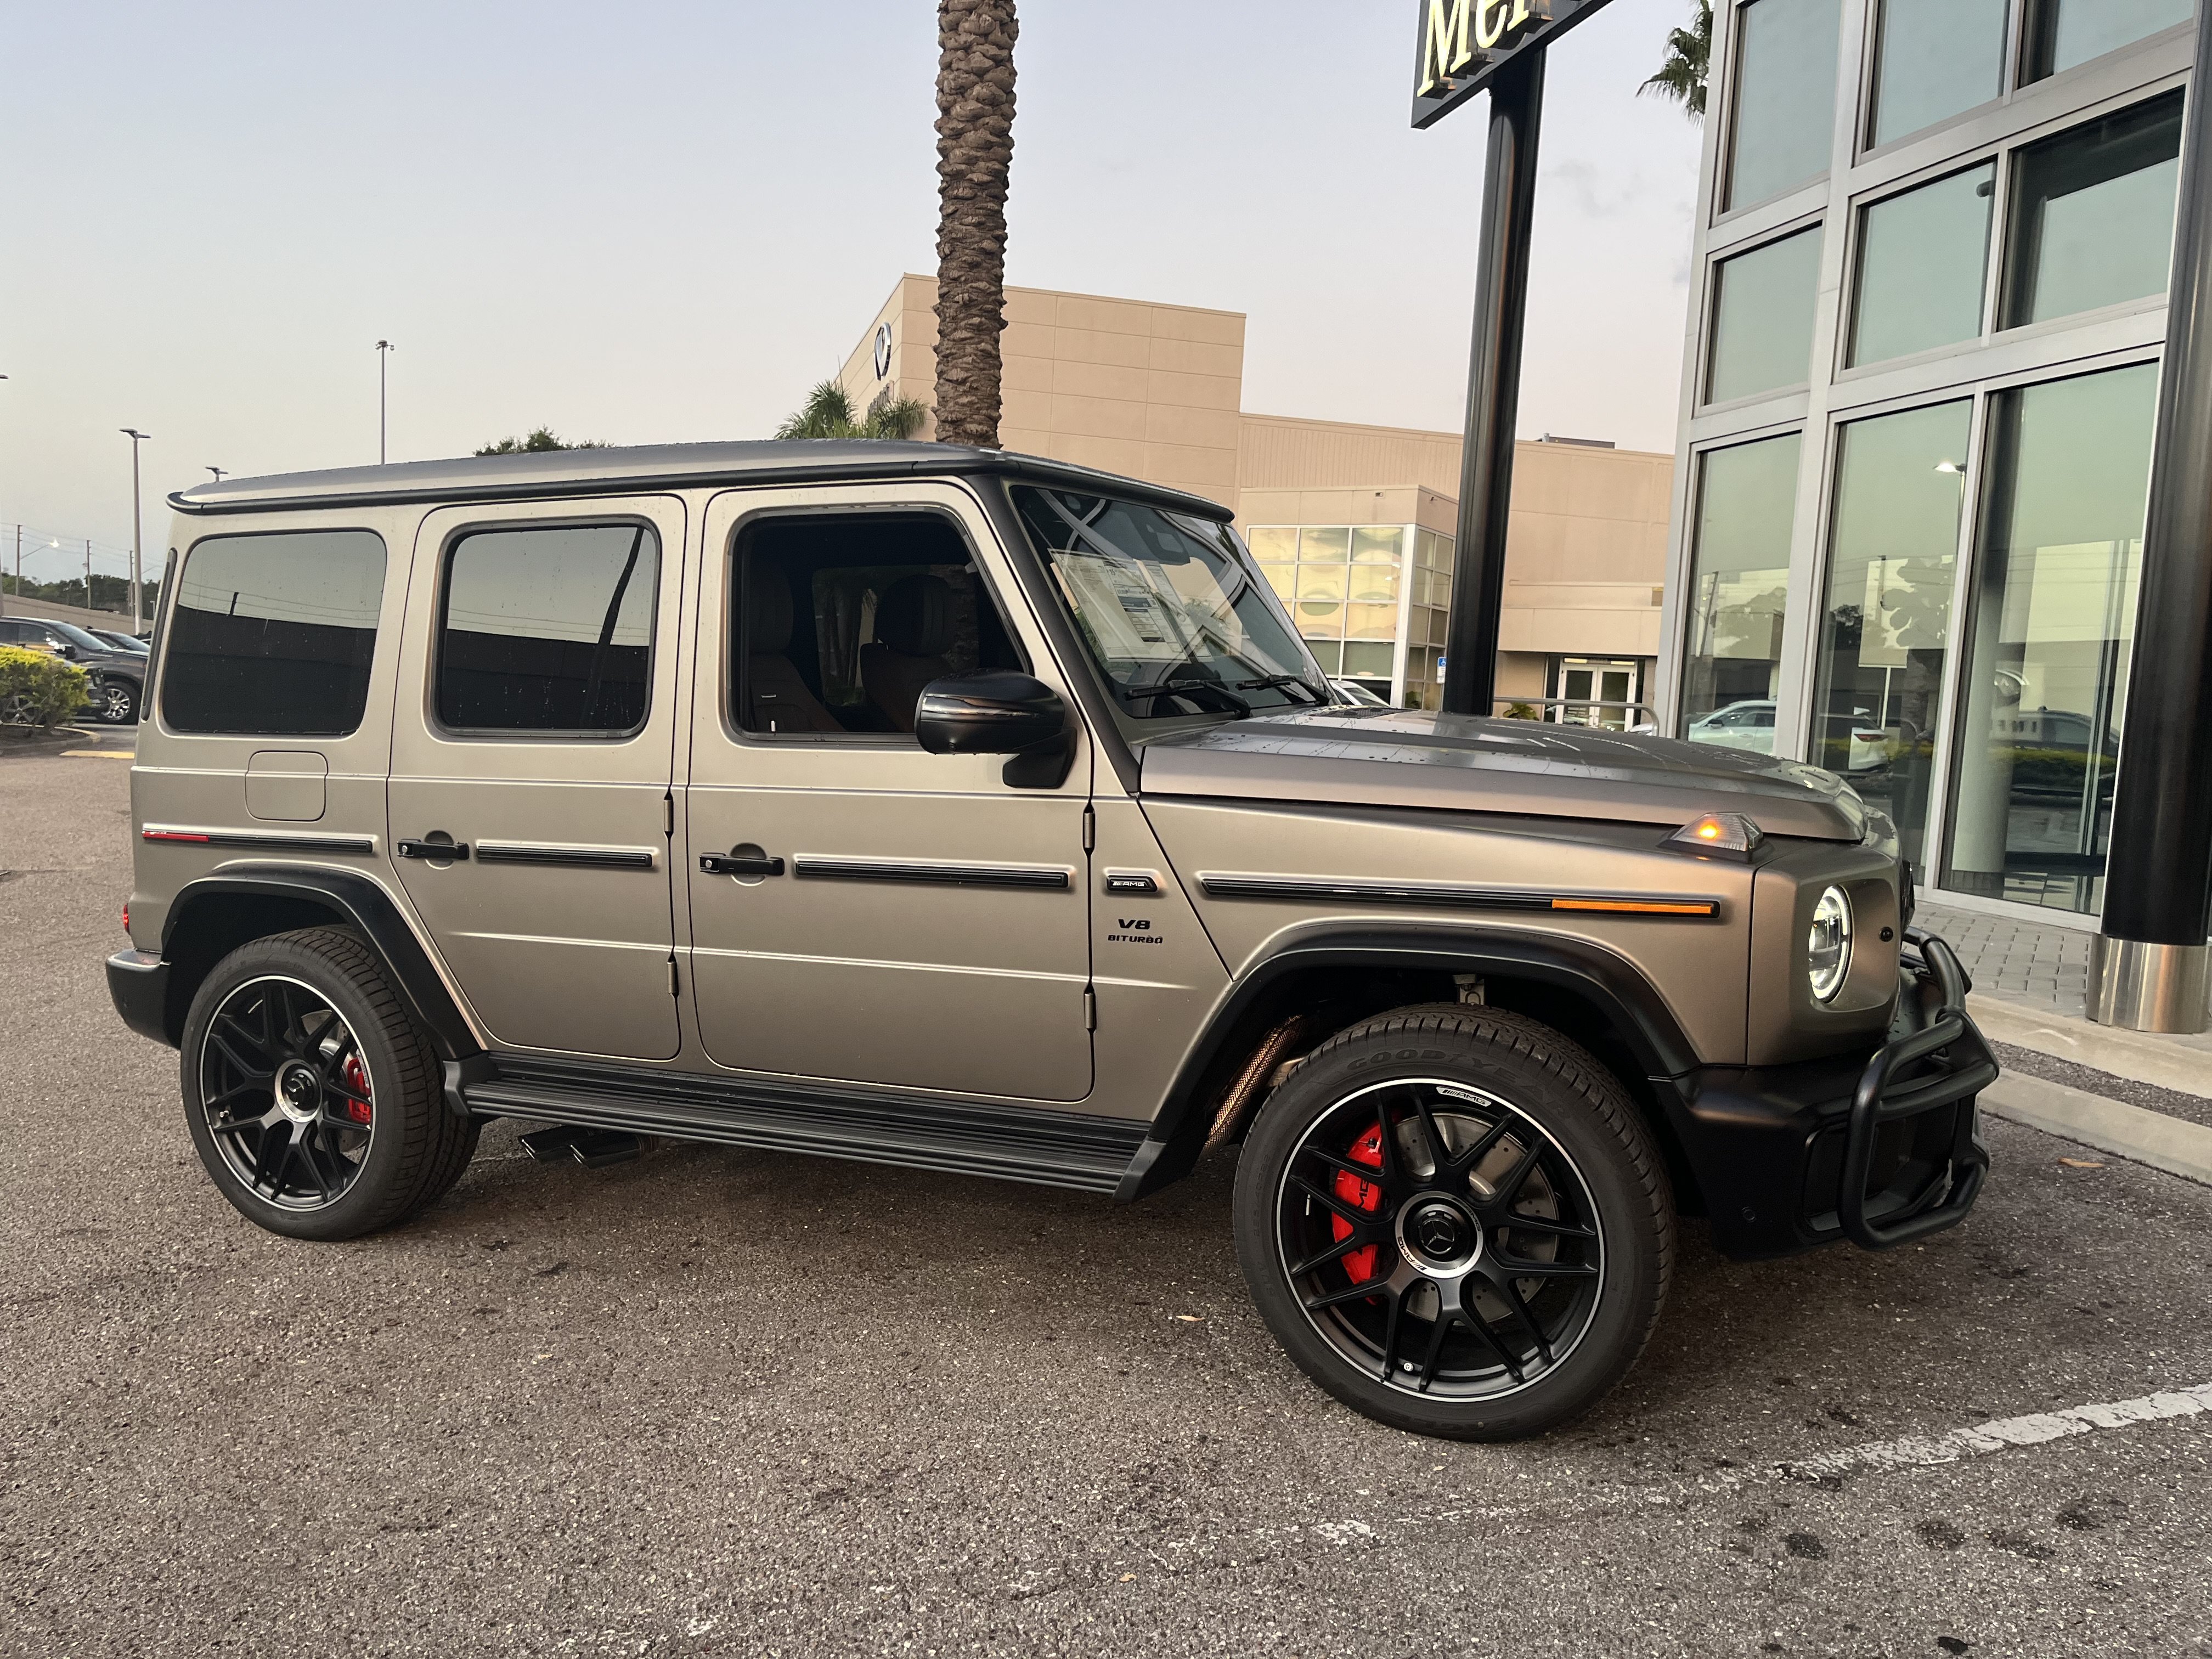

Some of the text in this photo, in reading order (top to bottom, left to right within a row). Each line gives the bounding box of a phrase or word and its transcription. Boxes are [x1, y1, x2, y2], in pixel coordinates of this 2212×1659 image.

[1118, 918, 1150, 930] V8
[1108, 934, 1163, 944] BITURBO
[1455, 1092, 1486, 1105] AMG
[1397, 1236, 1416, 1263] AMG
